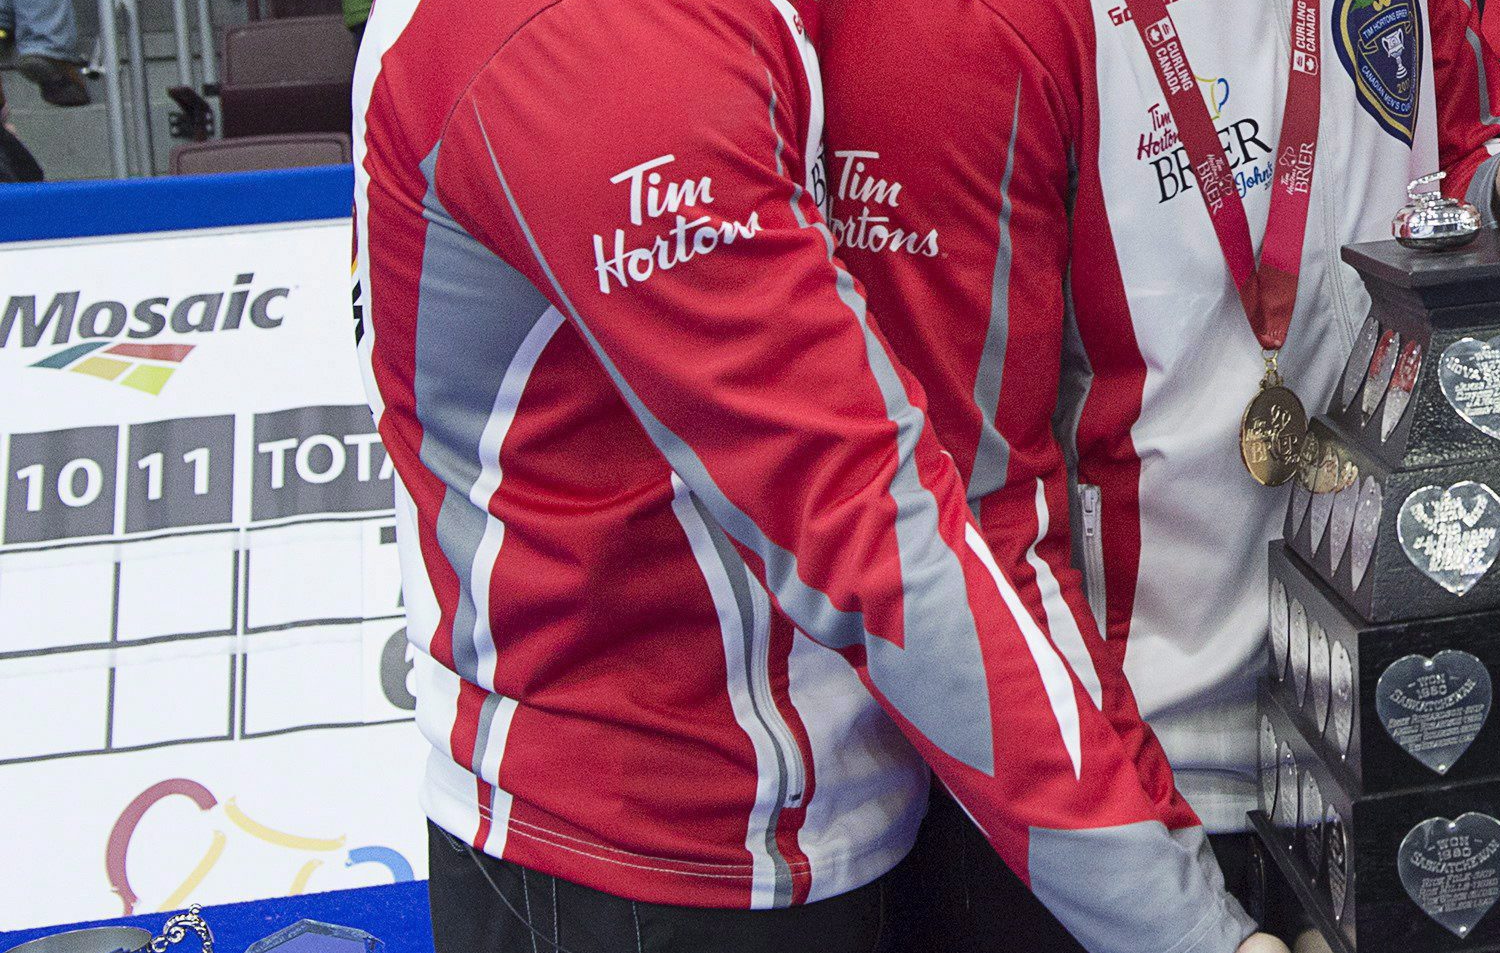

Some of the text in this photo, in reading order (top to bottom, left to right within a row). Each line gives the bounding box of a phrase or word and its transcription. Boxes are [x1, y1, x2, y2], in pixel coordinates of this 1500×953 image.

[1295, 0, 1308, 51] CURLING
[1305, 6, 1318, 54] CANADA
[1373, 12, 1397, 34] HORTONS
[1155, 46, 1181, 96] CANADA
[1166, 40, 1195, 92] CURLING
[1361, 64, 1384, 101] CANADIAN
[1136, 128, 1182, 161] Horton
[1148, 103, 1173, 133] Tim
[834, 149, 903, 208] Tim
[1149, 118, 1273, 204] BRER
[1294, 141, 1315, 194] BRIER
[609, 153, 715, 226] Tim
[1197, 161, 1225, 215] BRIER
[0, 272, 291, 349] Mosaic
[16, 458, 103, 512] 10
[138, 447, 211, 501] 11
[258, 434, 395, 490] TOT
